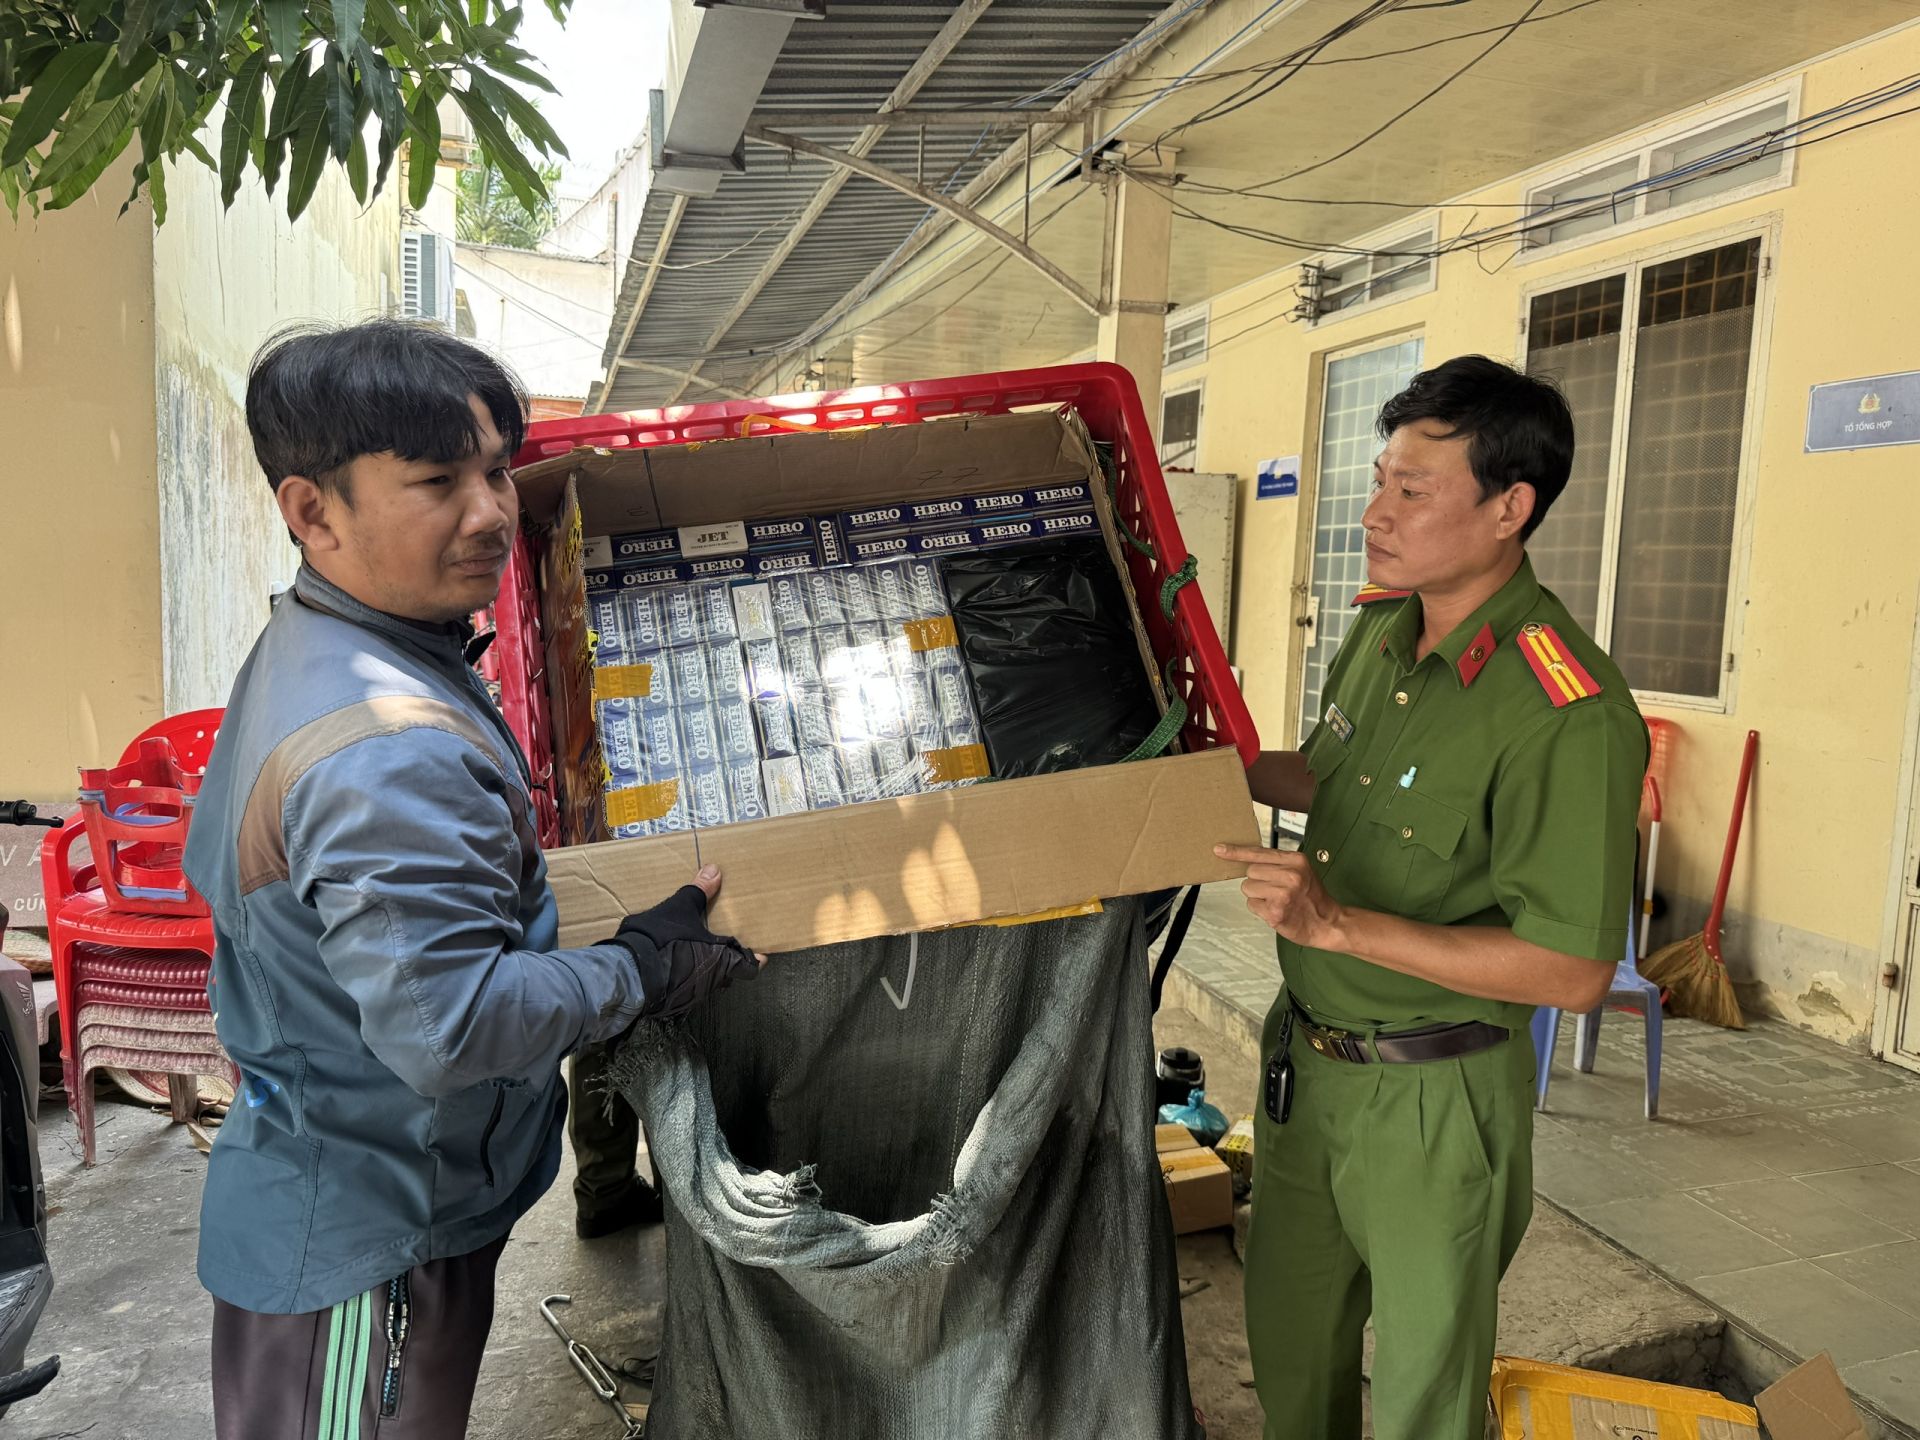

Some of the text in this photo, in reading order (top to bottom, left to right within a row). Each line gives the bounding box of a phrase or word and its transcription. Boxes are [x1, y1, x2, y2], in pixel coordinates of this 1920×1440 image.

[913, 501, 963, 516] HERO
[974, 494, 1024, 508] HERO
[1034, 486, 1084, 501] HERO
[697, 531, 729, 543] JET
[751, 522, 804, 537] HERO
[850, 508, 900, 525] HERO
[981, 523, 1031, 538] HERO
[1042, 515, 1092, 529] HERO
[620, 539, 675, 554] HERO
[819, 520, 838, 563] HERO
[856, 539, 907, 555] HERO
[921, 533, 972, 549] HERO
[623, 569, 678, 585] HERO
[691, 558, 745, 573] HERO
[759, 555, 812, 571] HERO
[777, 580, 796, 622] HERO
[812, 577, 832, 620] HERO
[847, 573, 866, 615] HERO
[882, 569, 901, 614] HERO
[916, 565, 935, 610] HERO
[600, 602, 616, 648] HERO
[637, 597, 654, 643] HERO
[673, 593, 691, 638] HERO
[709, 588, 727, 633] HERO
[683, 651, 701, 698] HERO
[719, 646, 737, 692] HERO
[612, 719, 631, 769] HERO
[652, 715, 671, 765] HERO
[691, 711, 709, 759] HERO
[728, 704, 747, 752] HERO
[698, 772, 719, 824] HERO
[740, 765, 758, 817] HERO
